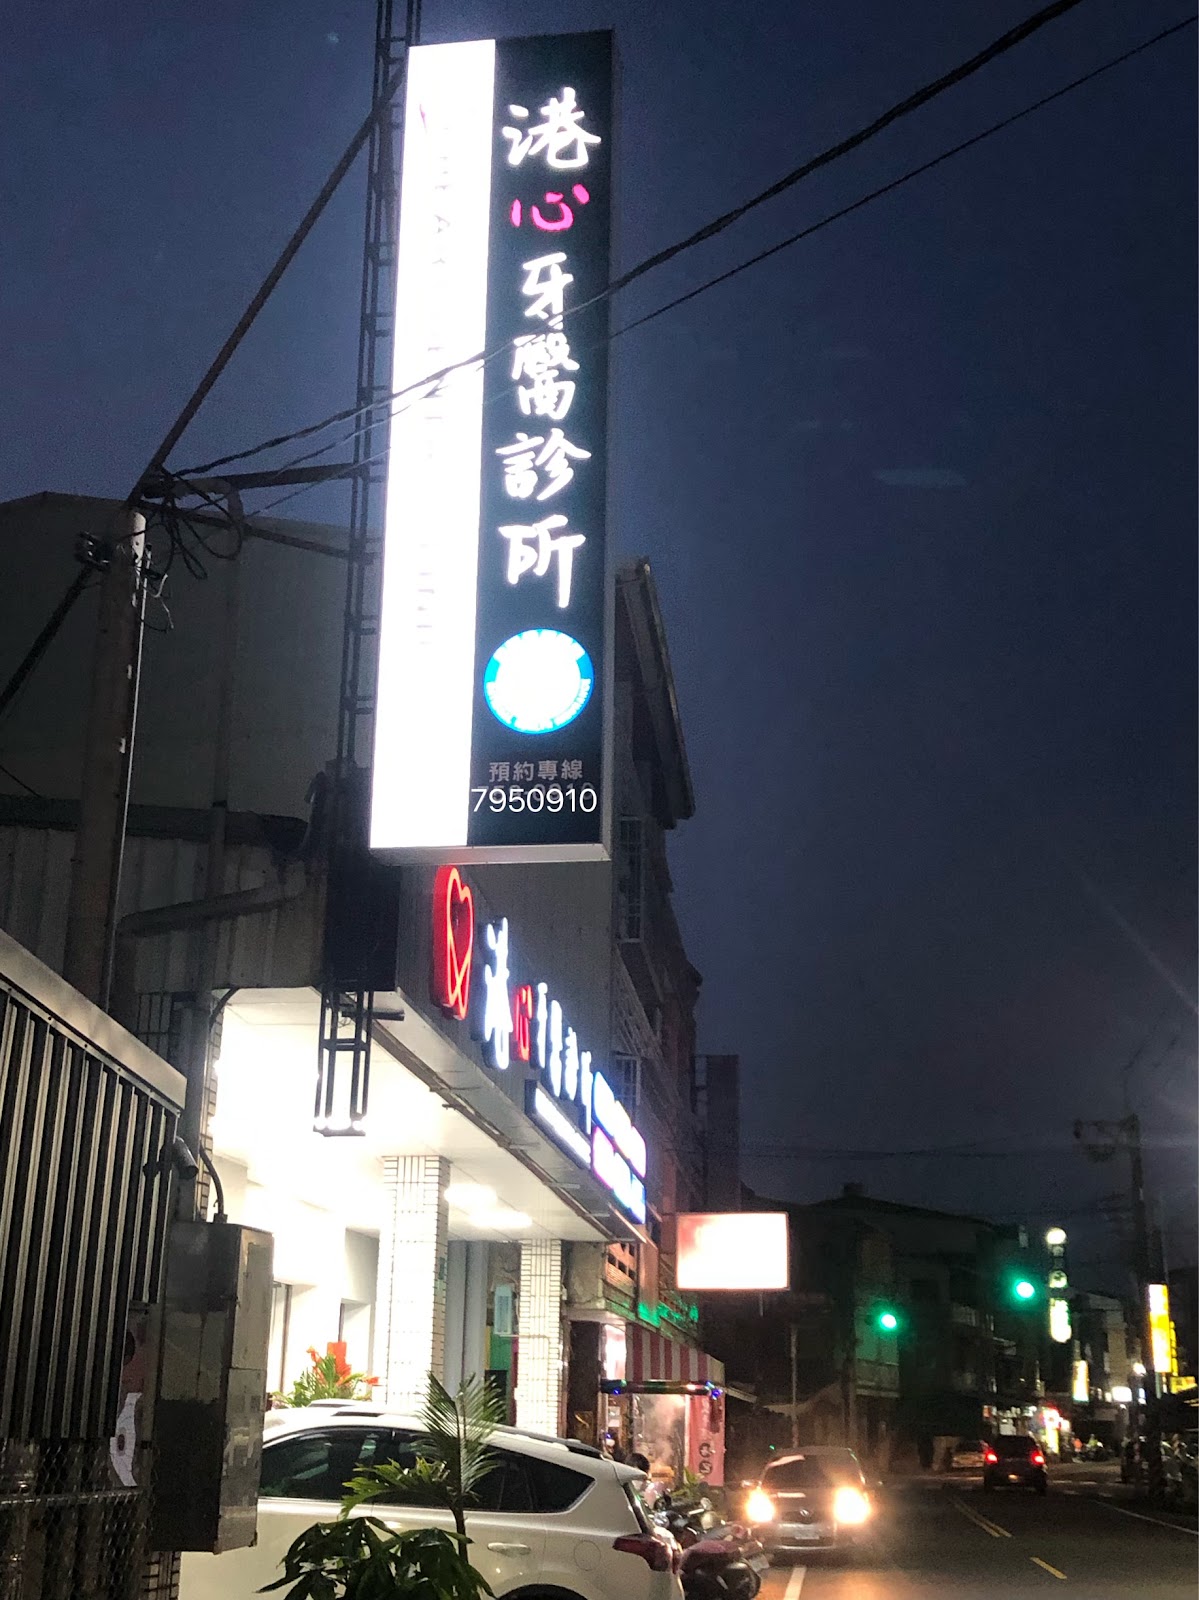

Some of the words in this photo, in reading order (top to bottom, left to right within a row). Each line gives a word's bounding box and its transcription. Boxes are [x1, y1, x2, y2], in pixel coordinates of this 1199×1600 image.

[495, 86, 601, 609] 港心牙醫診所
[488, 759, 584, 782] 預約專線
